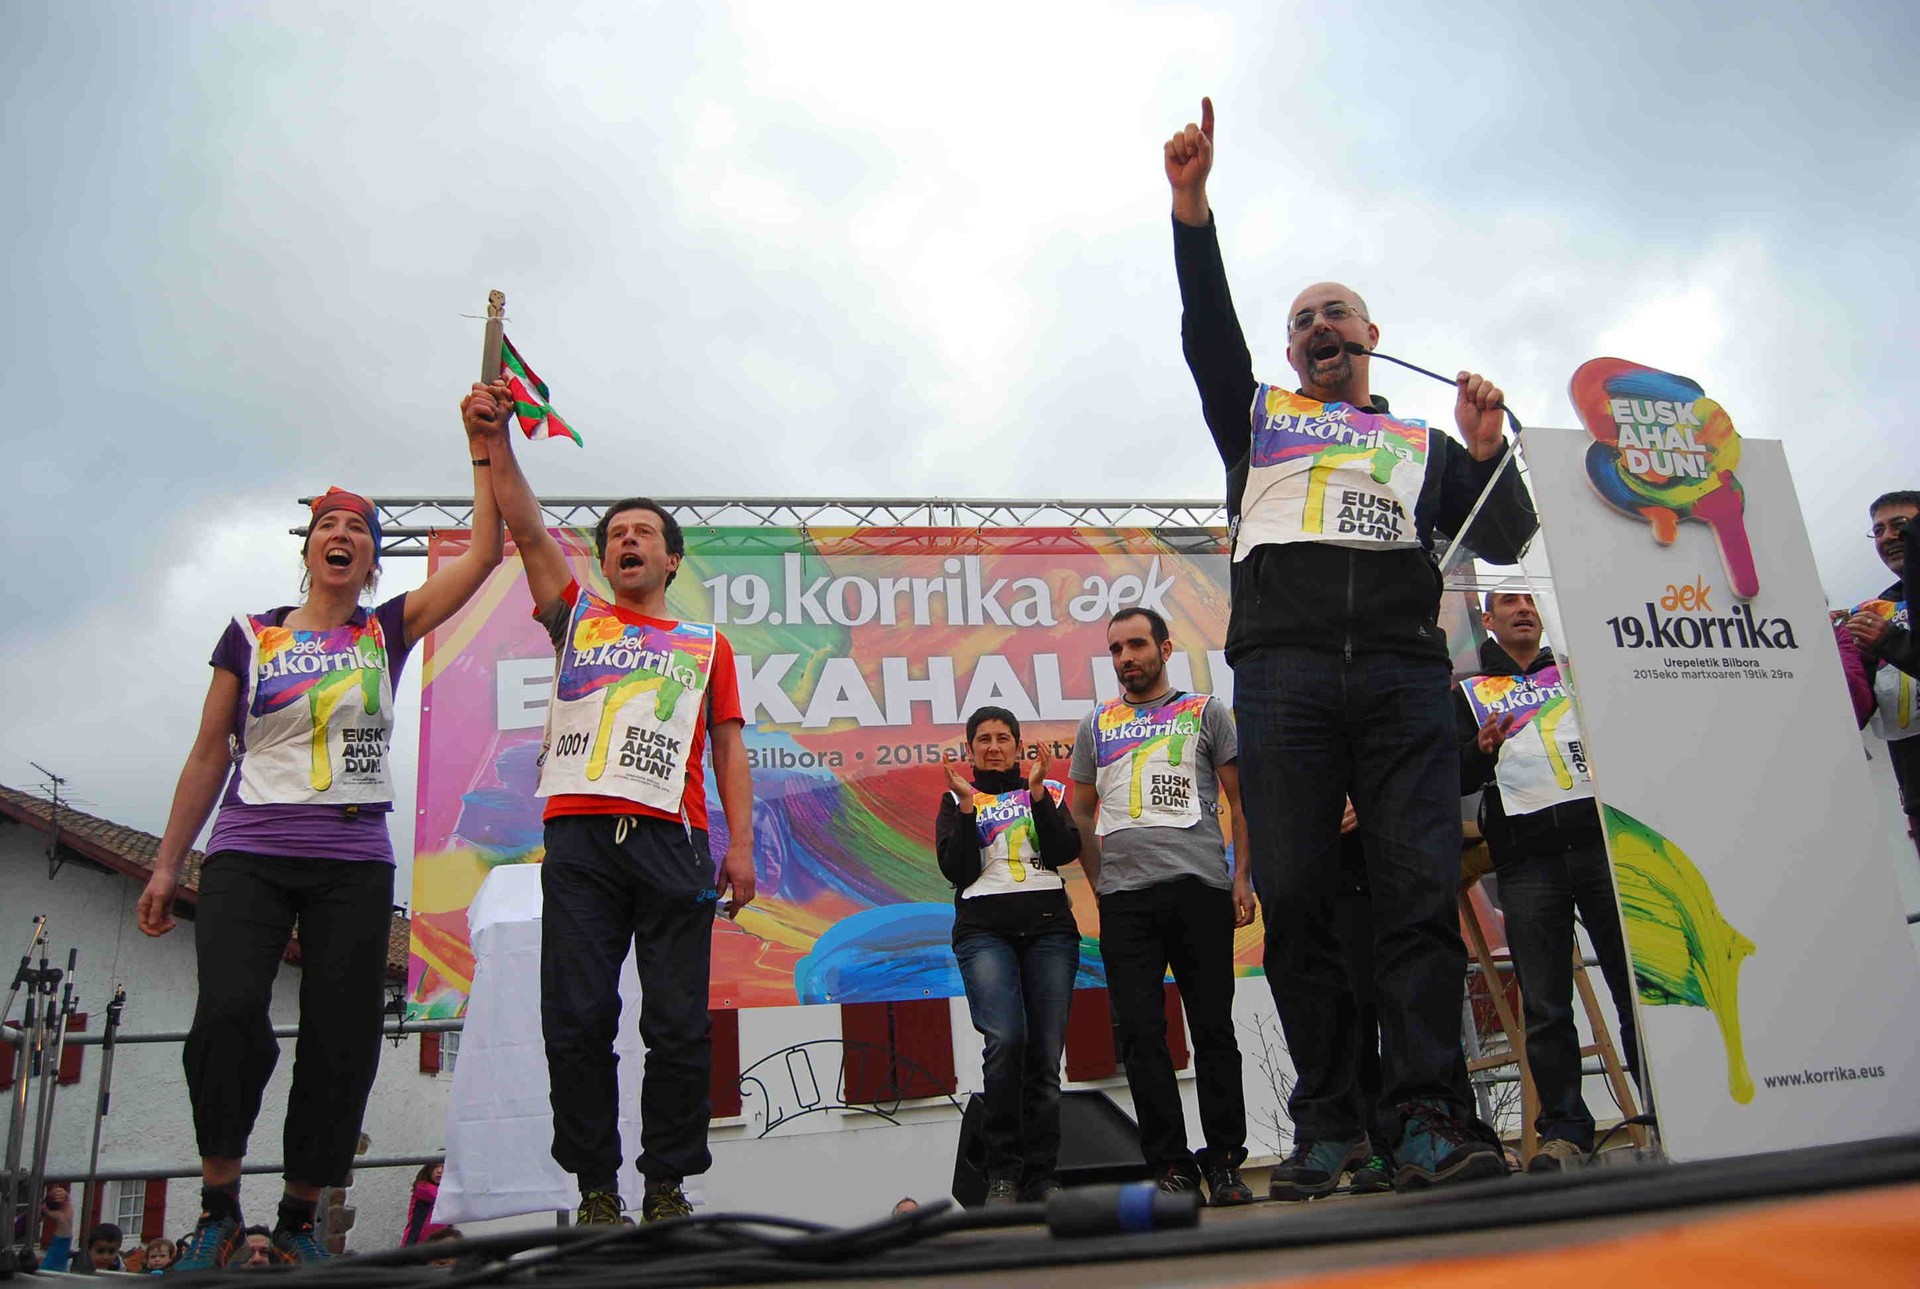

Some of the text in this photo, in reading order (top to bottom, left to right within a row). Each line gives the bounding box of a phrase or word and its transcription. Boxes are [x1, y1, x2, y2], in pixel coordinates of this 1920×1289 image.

[1314, 407, 1350, 423] aek
[1610, 399, 1700, 425] EUSK
[1618, 424, 1706, 452] AHAL
[1625, 449, 1708, 479] DUN!
[1341, 490, 1405, 520] EUSK
[1336, 506, 1402, 535] AHAL
[703, 552, 1176, 627] 19.korrika aek
[1660, 574, 1712, 612] aek
[1606, 602, 1799, 649] 19.korrika
[292, 637, 325, 654] aek
[615, 632, 646, 650] aek
[258, 644, 385, 682] 9.korrik
[573, 643, 697, 690] 19.korrika
[1633, 669, 1794, 680] 2015eko martxoaren 19tik 29ra
[1663, 657, 1760, 669] Urepeletik Bilbora
[1100, 719, 1195, 743] 19.korrika
[1131, 713, 1153, 726] aek
[342, 727, 387, 743] EUSK
[556, 732, 590, 757] 0001
[625, 725, 681, 754] EUSK
[342, 744, 383, 758] AHAL
[619, 740, 676, 768] AHAL
[748, 748, 843, 769] Bilbora
[619, 753, 672, 780] DUN!
[1150, 785, 1190, 799] AHAL
[1151, 774, 1191, 789] EUSK
[996, 794, 1018, 810] aek
[1151, 796, 1190, 808] DUN!
[1764, 1066, 1885, 1088] www.korrika.eus
